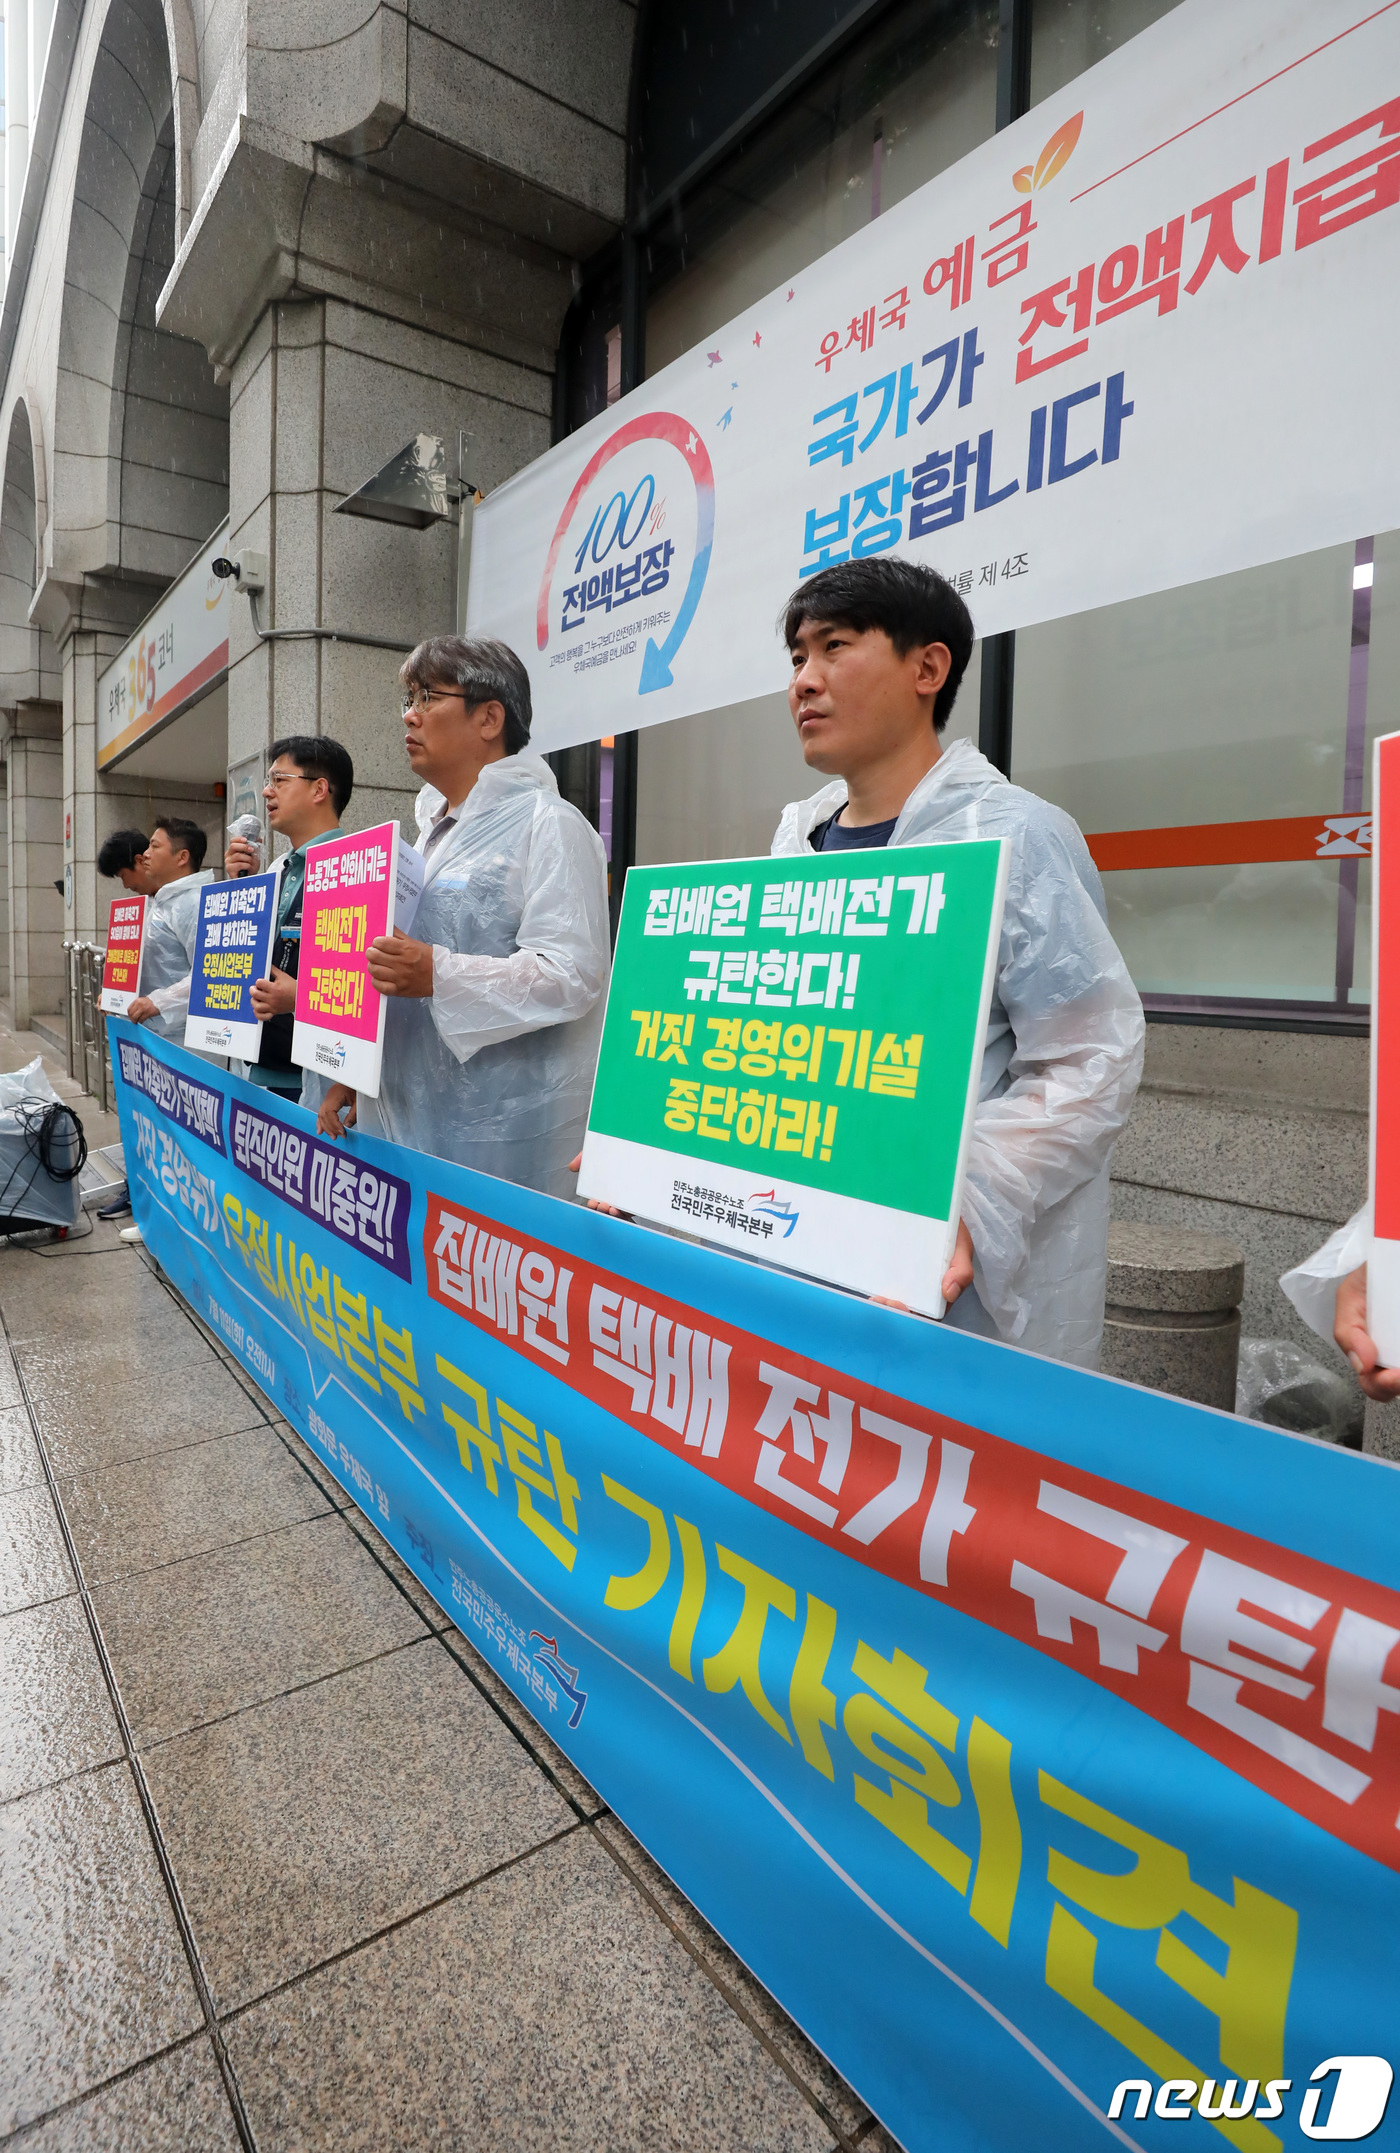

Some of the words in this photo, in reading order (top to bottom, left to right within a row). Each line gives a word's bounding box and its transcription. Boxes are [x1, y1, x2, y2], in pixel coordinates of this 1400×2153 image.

[807, 326, 985, 468] 국가가
[1015, 96, 1400, 384] 전액지급
[815, 285, 911, 374] 우체국
[923, 199, 1038, 311] 예금
[799, 371, 1135, 579] 보장합니다
[574, 474, 667, 574] 100%
[561, 538, 675, 633] 전액보장
[979, 561, 997, 586] 제
[1001, 552, 1029, 580] 4조
[108, 676, 126, 722] 우체국
[128, 633, 156, 722] 365
[158, 622, 174, 671] 코너
[550, 654, 566, 668] 고객의
[616, 620, 642, 641] 안전하게
[642, 610, 671, 631] 키워주는
[204, 891, 228, 918] 집배원
[229, 885, 267, 915] 저축연가
[306, 856, 339, 893] 노동강도
[340, 845, 388, 888] 악화시키는
[643, 883, 752, 937] 집배원
[759, 872, 946, 937] 택배전가
[202, 953, 253, 979] 우정사업본부
[222, 919, 258, 947] 방치하는
[315, 904, 367, 953] 택배전가
[205, 983, 242, 1010] 규탄한다!
[309, 967, 365, 1019] 규탄한다!
[683, 949, 861, 1010] 규탄한다!
[630, 1009, 695, 1066] 거짓
[701, 1016, 925, 1099] 경영위기설
[663, 1077, 838, 1162] 중단하라!
[234, 1109, 307, 1204] 퇴직인원
[310, 1148, 398, 1260] 미충원!
[671, 1193, 774, 1239] 전국민주우체국본부
[674, 1180, 745, 1210] 민주노총공공운수노조
[432, 1210, 574, 1367] 집배원
[588, 1283, 732, 1459] 택배
[752, 1360, 977, 1588] 전가
[307, 1404, 338, 1461] 광화문
[339, 1441, 374, 1504] 우체국
[375, 1483, 390, 1522] 앞
[132, 1109, 159, 1180] 거짓
[157, 1129, 231, 1249] 경영위기
[223, 1192, 426, 1424] 우정사업본부
[435, 1352, 582, 1573] 규탄
[600, 1472, 1299, 2153] 기자회견
[451, 1575, 558, 1713] 전국민주우체국본부
